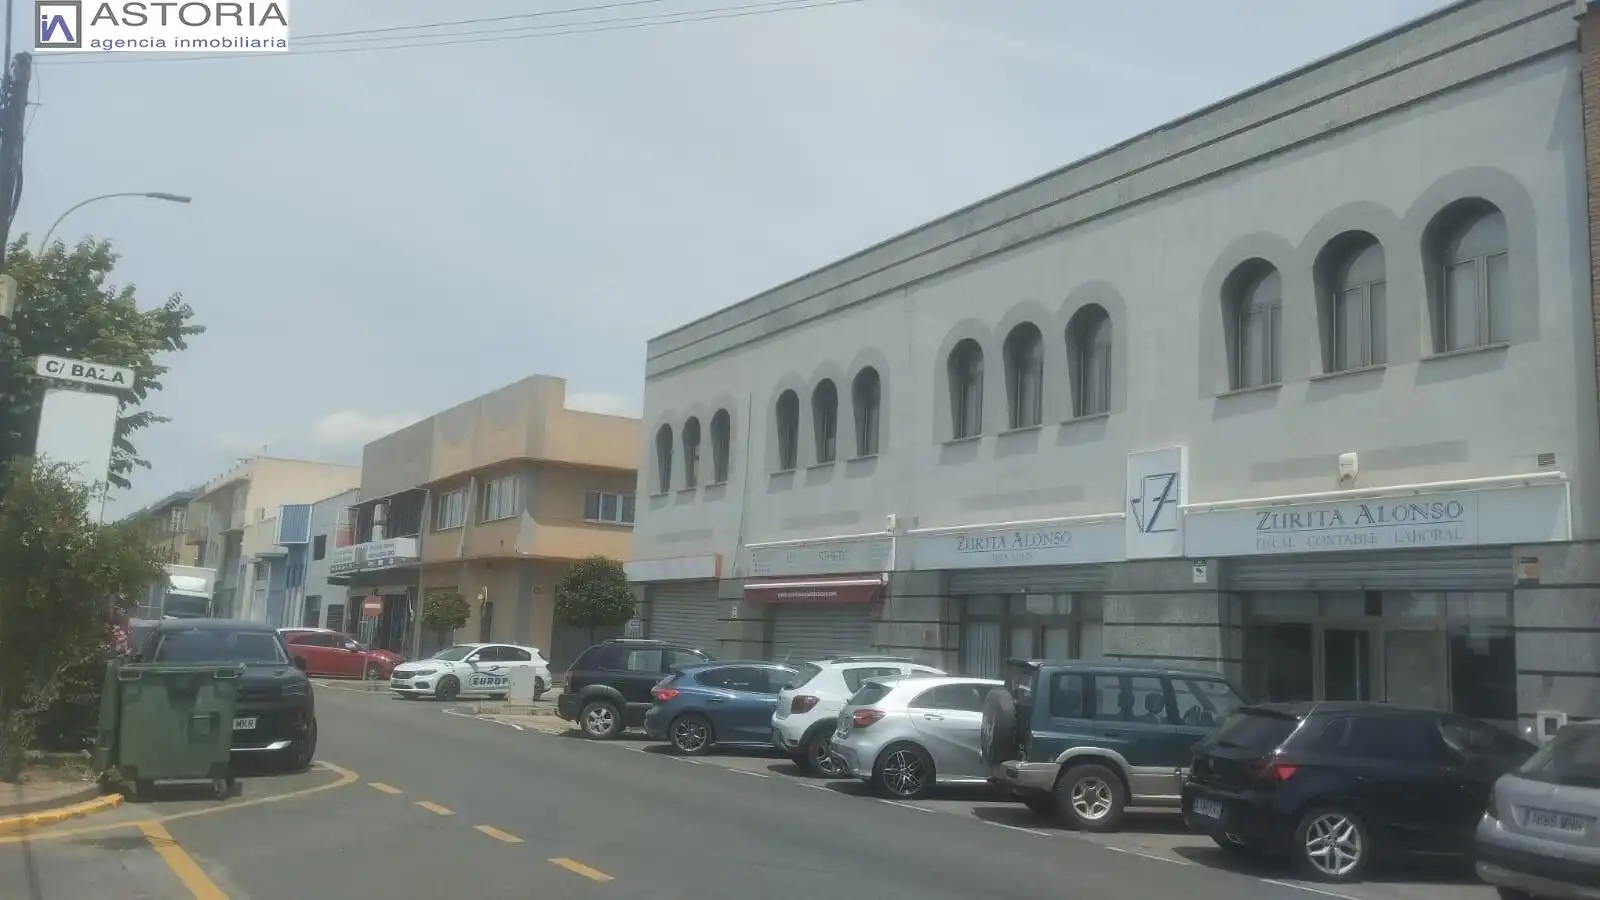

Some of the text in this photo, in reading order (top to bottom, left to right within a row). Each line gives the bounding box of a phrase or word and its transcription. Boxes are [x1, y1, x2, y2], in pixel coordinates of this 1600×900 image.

[46, 360, 66, 374] C/
[1256, 500, 1464, 531] ZURITA ALONSO
[956, 530, 1072, 551] ZURITA ALONSO
